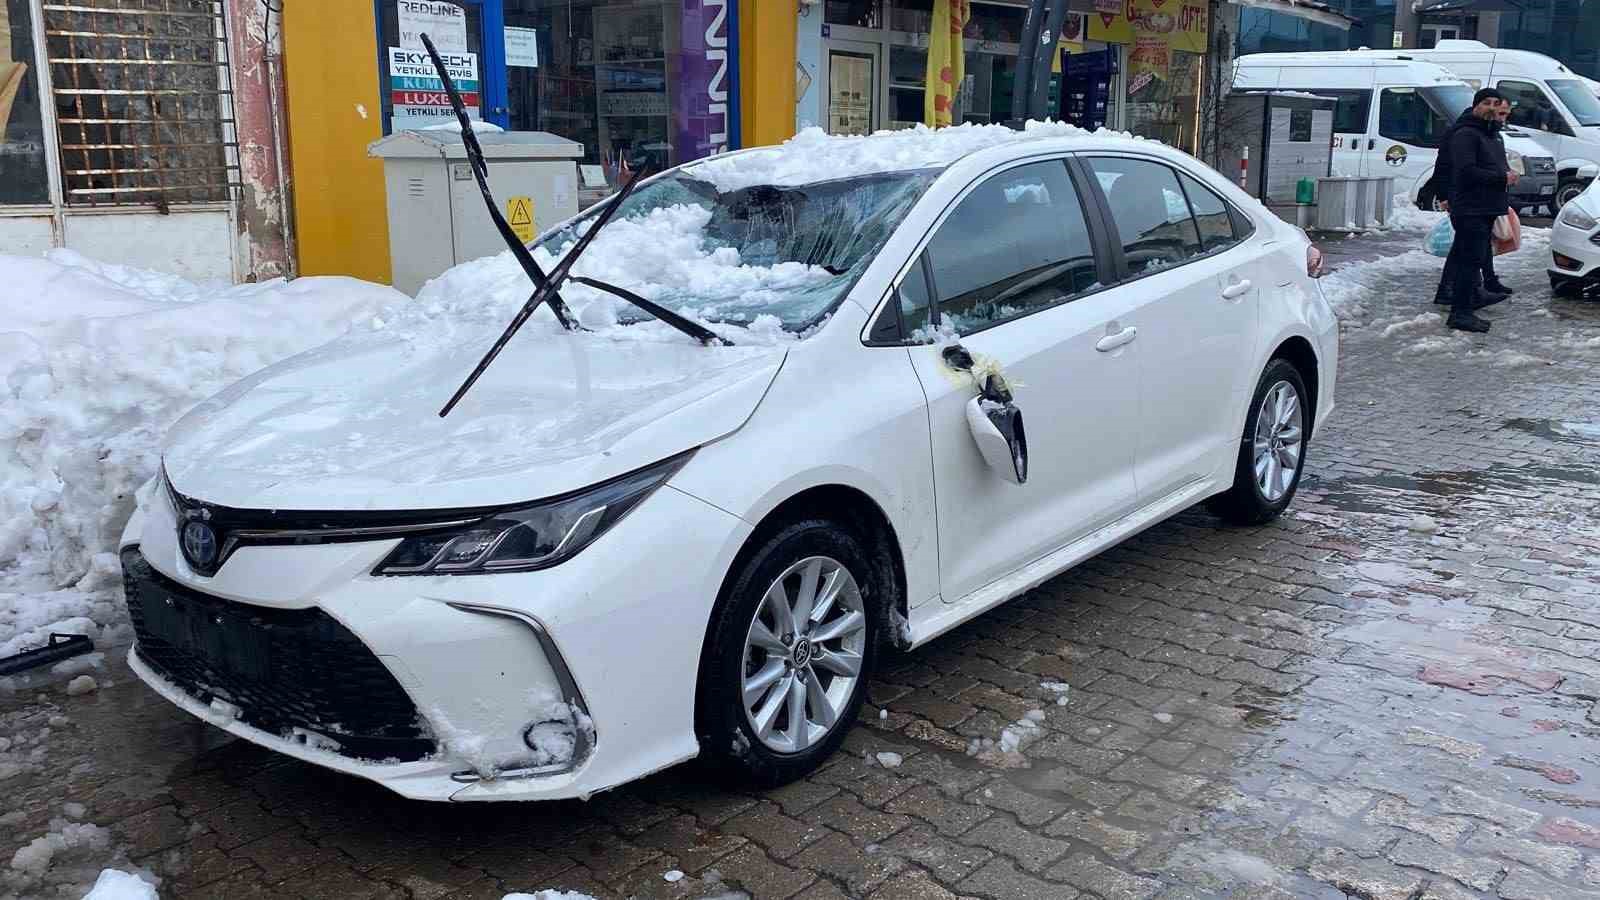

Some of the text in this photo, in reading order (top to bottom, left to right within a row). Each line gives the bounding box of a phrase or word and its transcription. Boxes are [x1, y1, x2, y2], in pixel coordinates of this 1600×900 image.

[400, 1, 461, 17] REDLINE
[394, 52, 472, 67] SKYECH
[448, 69, 472, 78] RVİS
[403, 77, 465, 90] KUML
